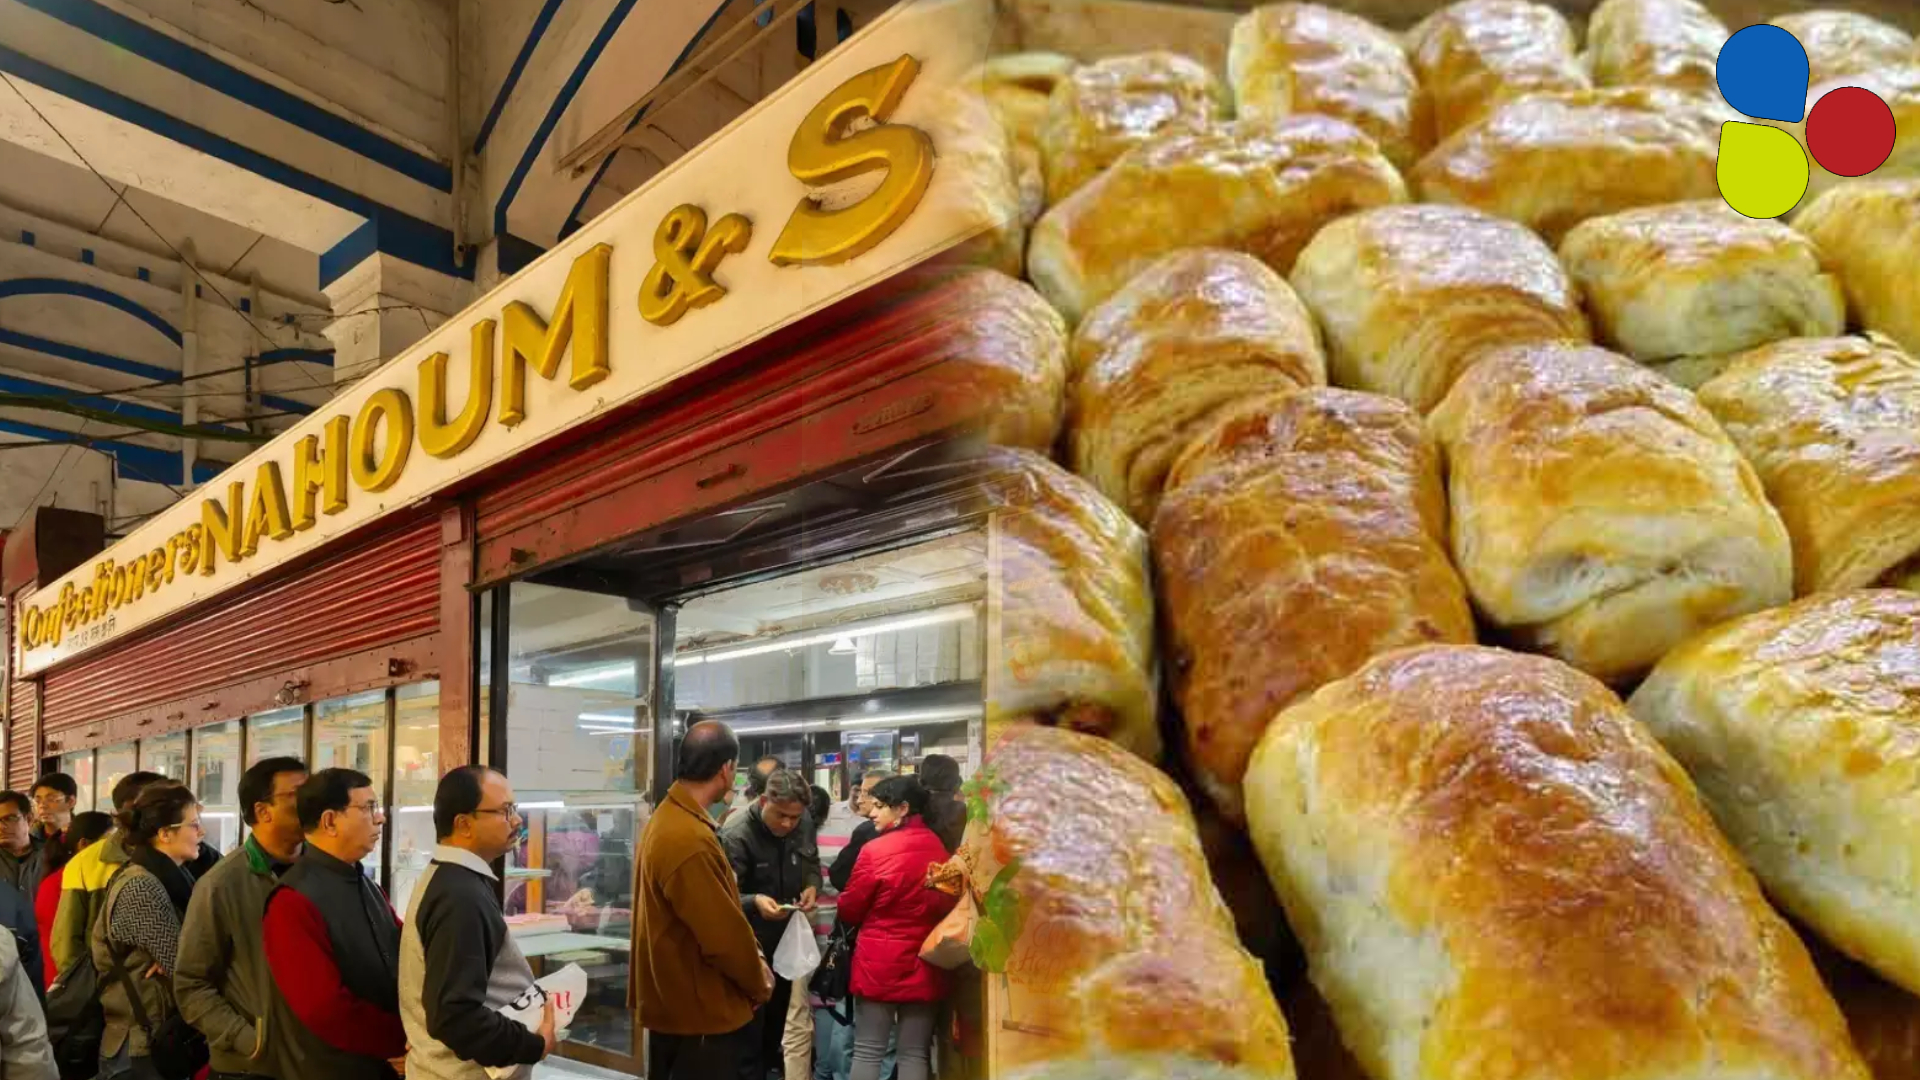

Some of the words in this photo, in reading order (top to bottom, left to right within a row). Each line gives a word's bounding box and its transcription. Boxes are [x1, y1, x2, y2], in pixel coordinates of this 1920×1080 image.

[201, 242, 613, 577] NAHOUM
[637, 202, 753, 327] &
[768, 52, 937, 266] S
